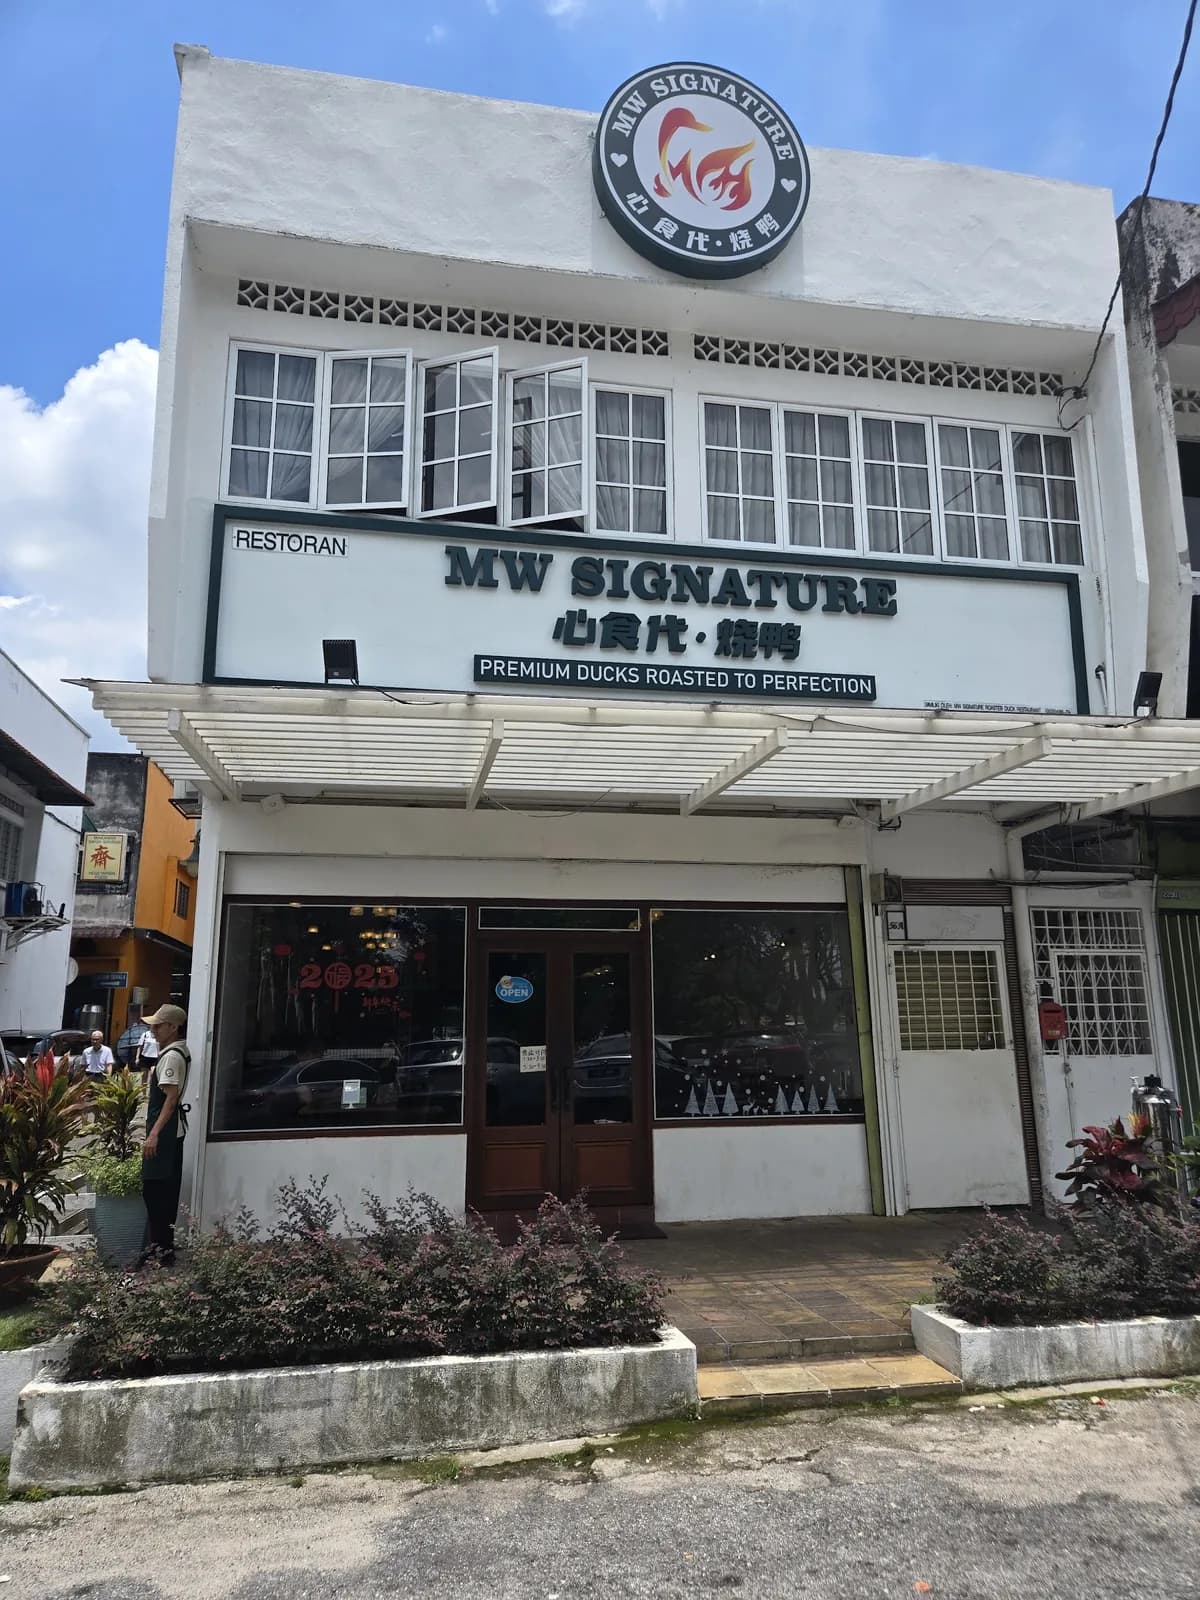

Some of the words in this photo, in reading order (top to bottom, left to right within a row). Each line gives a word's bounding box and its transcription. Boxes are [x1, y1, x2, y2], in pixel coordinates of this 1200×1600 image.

[612, 91, 647, 138] MW
[650, 73, 794, 160] SIGNATURE
[236, 529, 346, 555] RESTORAN
[445, 545, 554, 592] MW
[571, 556, 897, 616] SIGNATURE
[480, 659, 570, 680] PREMIUM
[577, 664, 640, 683] DUCKS
[646, 668, 728, 688] ROASTED
[734, 673, 756, 689] TO
[763, 674, 872, 694] PERFECTION
[500, 988, 529, 997] OPEN
